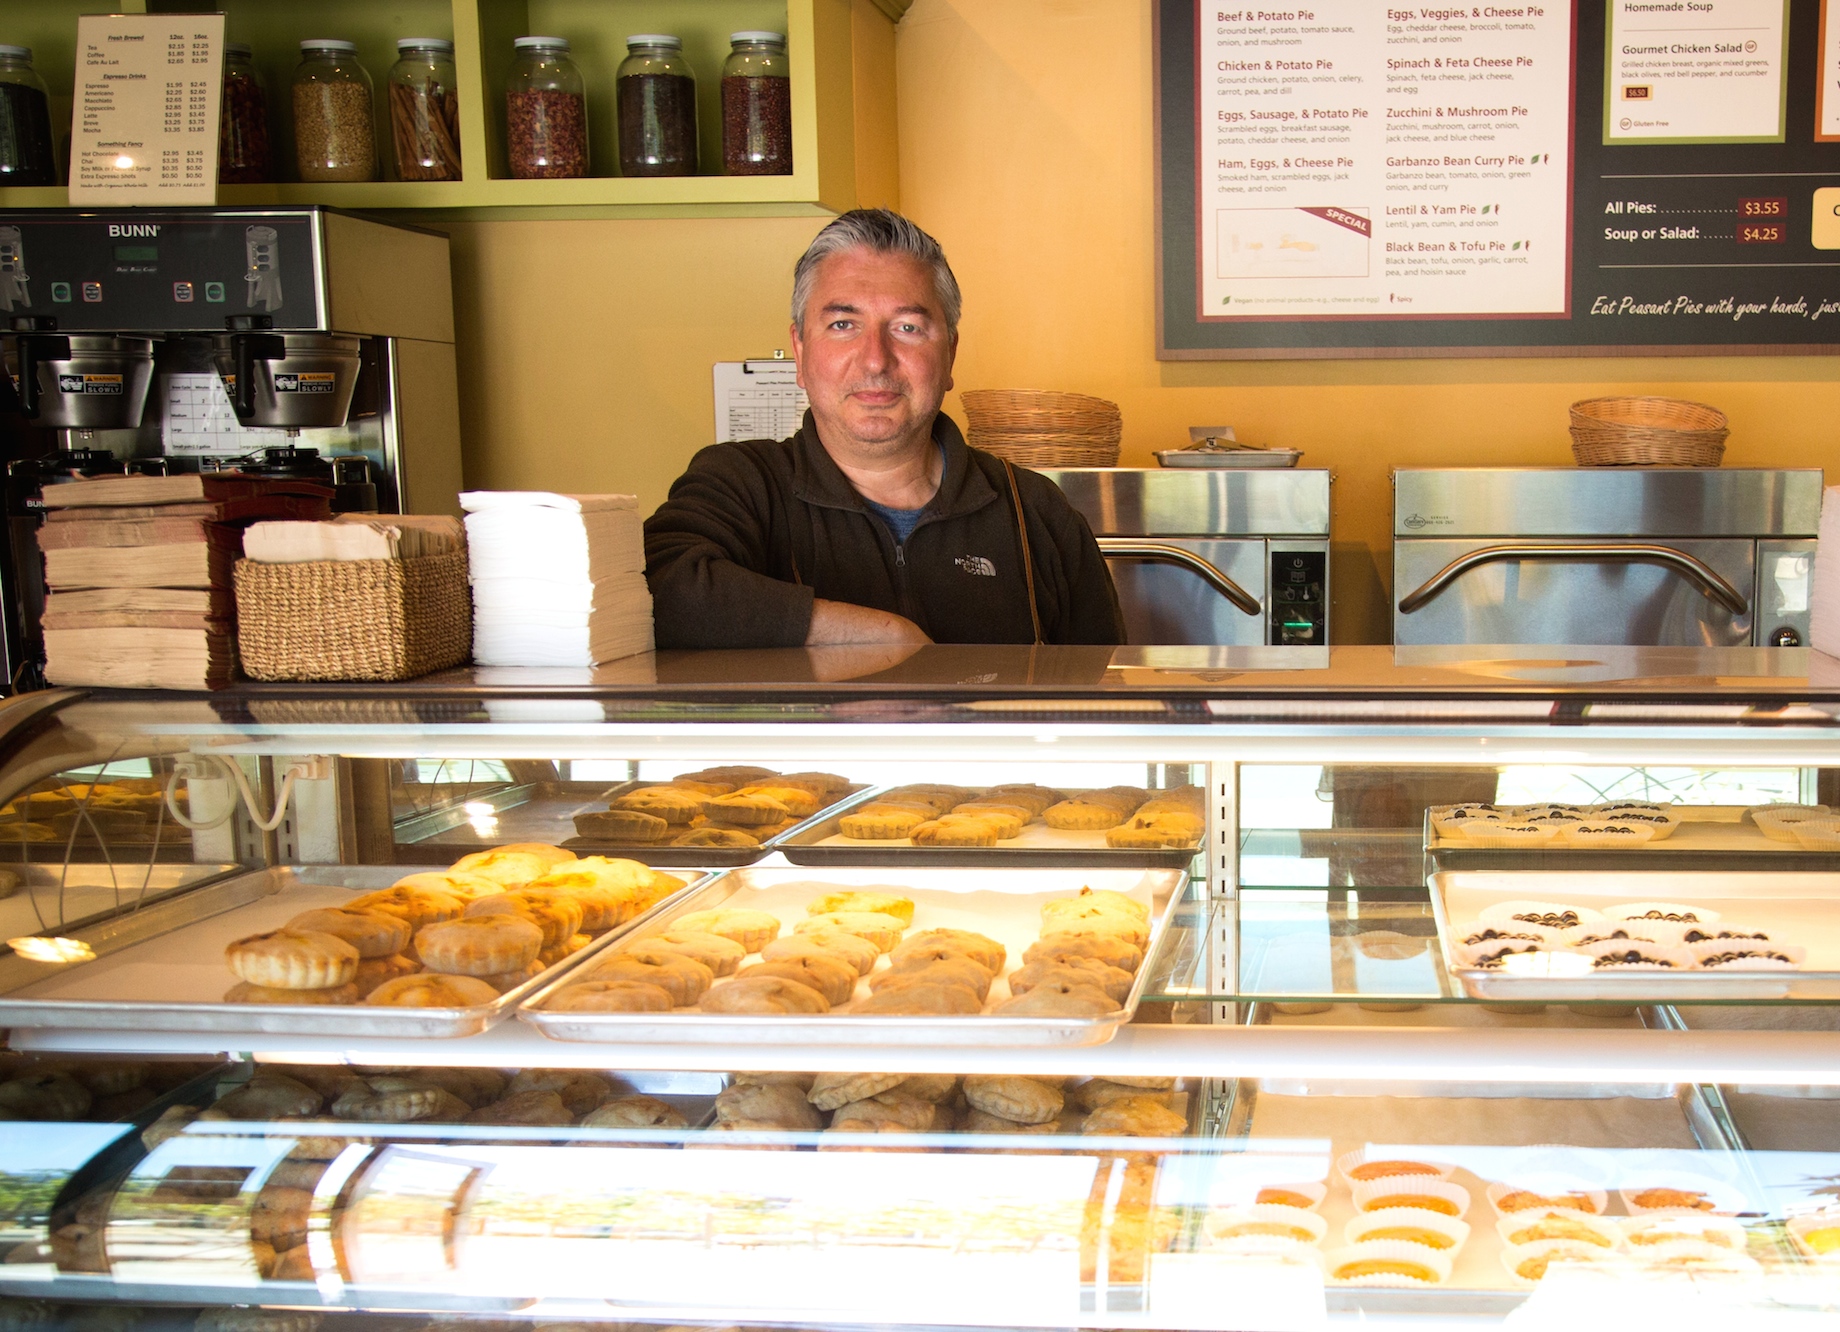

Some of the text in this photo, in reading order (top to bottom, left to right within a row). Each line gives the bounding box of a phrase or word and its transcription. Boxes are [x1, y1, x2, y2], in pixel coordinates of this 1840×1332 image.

[1625, 2, 1713, 13] Homemade Soup
[1218, 10, 1314, 22] Beef & Potato Pie
[1388, 7, 1544, 21] Eggs, Veggies, & Cheese Pie
[1622, 45, 1668, 54] Gourmet
[1671, 44, 1711, 54] Chicken
[1715, 44, 1742, 53] Salad
[1218, 60, 1333, 71] Chicken & Potato Pie
[1388, 57, 1533, 71] Spinach & Feta Cheese Pie
[1386, 74, 1418, 82] Spinach,
[1469, 73, 1484, 82] jack
[1628, 88, 1646, 97] $6.50
[1218, 108, 1368, 123] Eggs, Sausage, & Potato Pie
[1387, 106, 1528, 118] Zucchini & Mushroom Pie
[1219, 157, 1353, 170] Ham, Eggs, & Cheese Pie
[1386, 156, 1525, 168] Garbanzo Bean Curry Pie
[1386, 205, 1476, 215] Lentil & Yam Pie
[1605, 201, 1779, 215] All Pies: $3.55
[1326, 208, 1367, 231] SPECIAL
[109, 224, 158, 237] BUNN
[1605, 227, 1778, 242] Soup or Salad: $4.25
[1386, 241, 1506, 252] Black Bean & Tofu Pie
[1590, 296, 1840, 321] Eat Peasant Pies with your hands, jus
